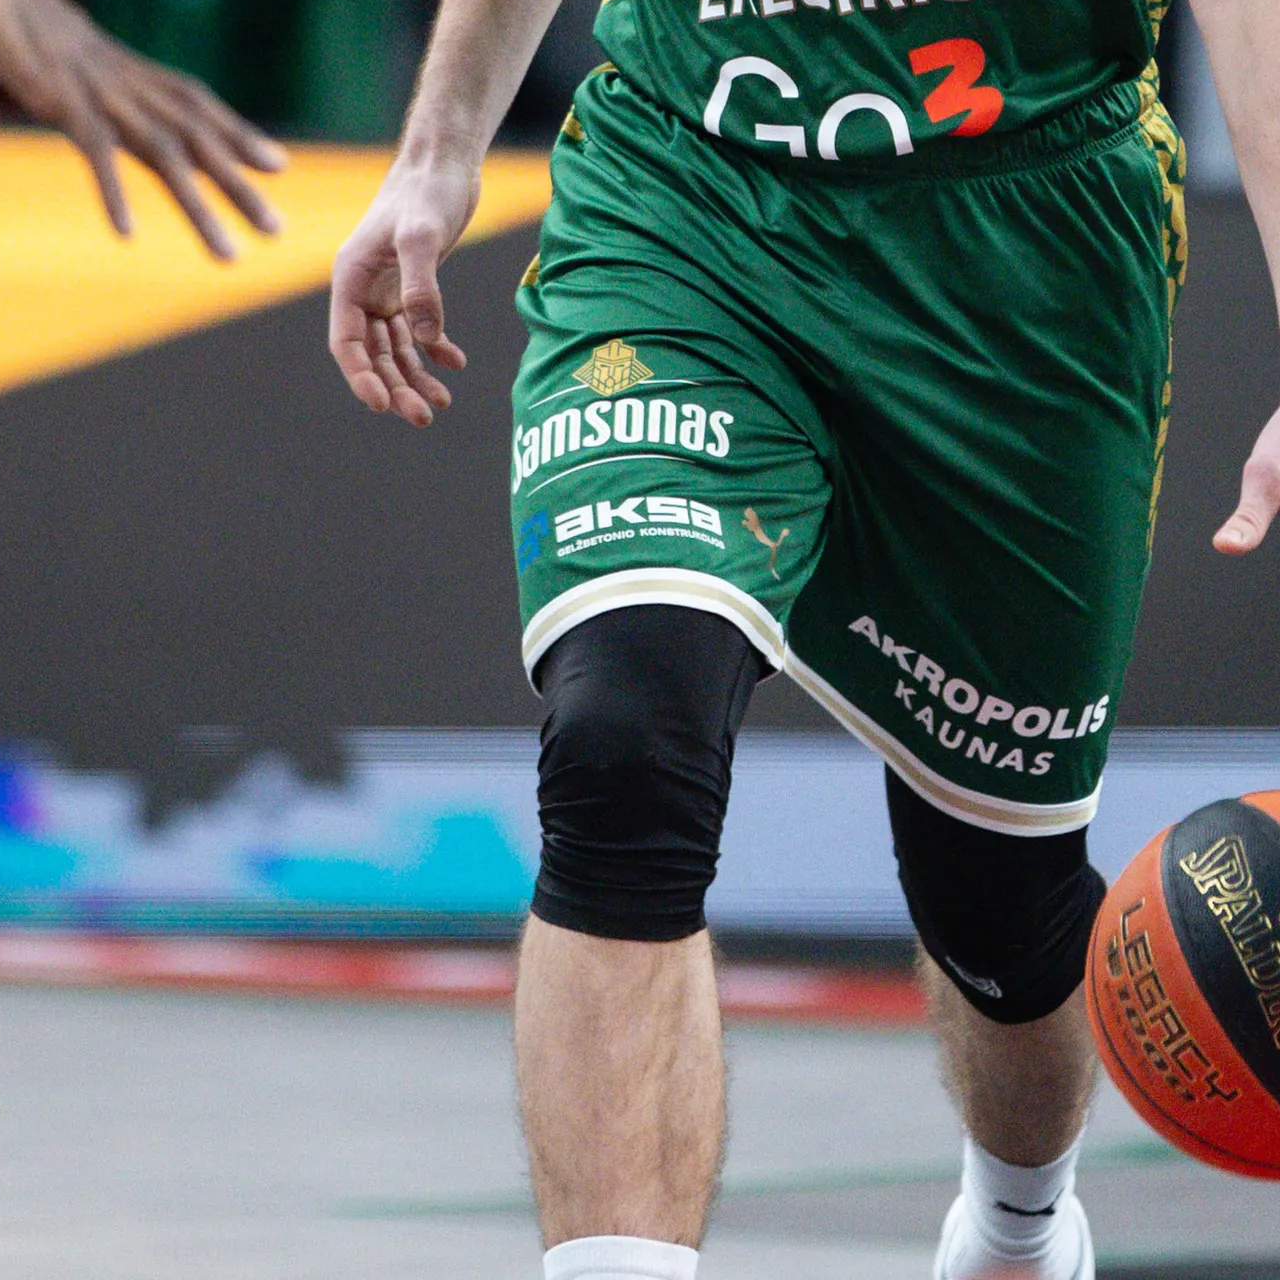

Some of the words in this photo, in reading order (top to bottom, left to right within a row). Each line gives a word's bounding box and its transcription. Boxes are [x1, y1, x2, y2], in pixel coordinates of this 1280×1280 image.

[848, 615, 1110, 740] AKROPOLIS
[893, 679, 1055, 776] KAUNAS
[1120, 897, 1242, 1102] LEGACY
